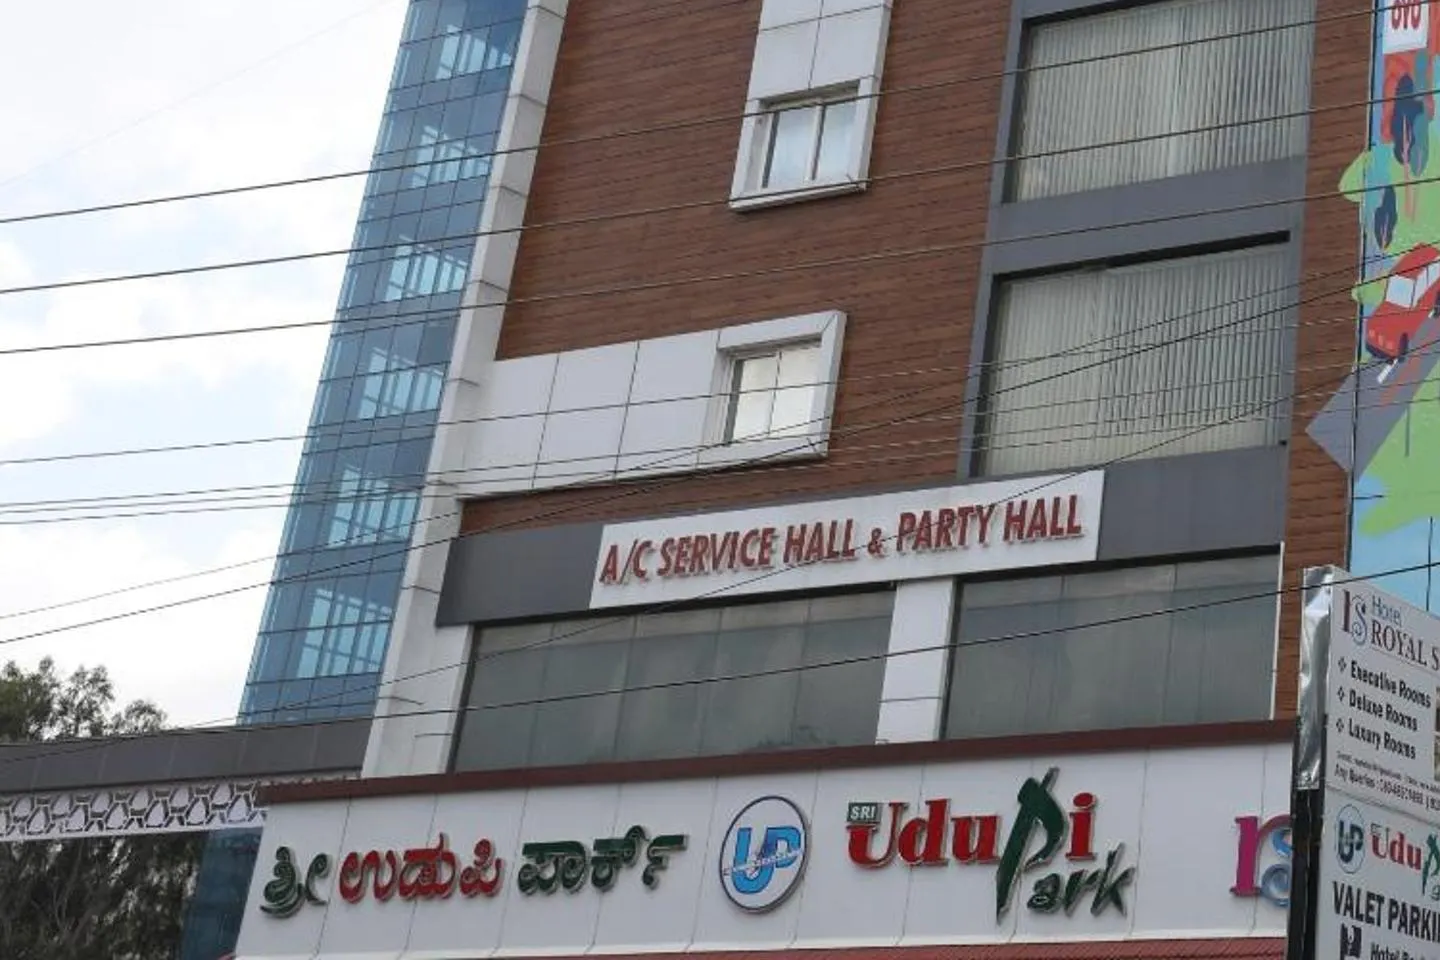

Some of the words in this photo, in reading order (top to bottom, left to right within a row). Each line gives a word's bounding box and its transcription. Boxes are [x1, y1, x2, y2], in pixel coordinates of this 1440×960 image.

[600, 537, 657, 585] A/C
[655, 527, 776, 577] SERVICE
[783, 518, 856, 565] HALL
[866, 527, 883, 556] &
[896, 504, 996, 552] PARTY
[1003, 494, 1083, 541] HALL
[1372, 595, 1402, 627] Hotel
[1370, 619, 1427, 667] ROYAL
[1350, 659, 1397, 695] Executive
[1399, 680, 1431, 709] Rooms
[1349, 689, 1383, 718] Deluxe
[1385, 703, 1418, 732] Rooms
[1348, 718, 1381, 750] Luxury
[1383, 731, 1416, 760] Rooms
[849, 804, 878, 822] SRI
[339, 832, 505, 904] ಉಡುಪಿ
[846, 767, 1097, 926] Udupi
[1332, 880, 1385, 928] VALET
